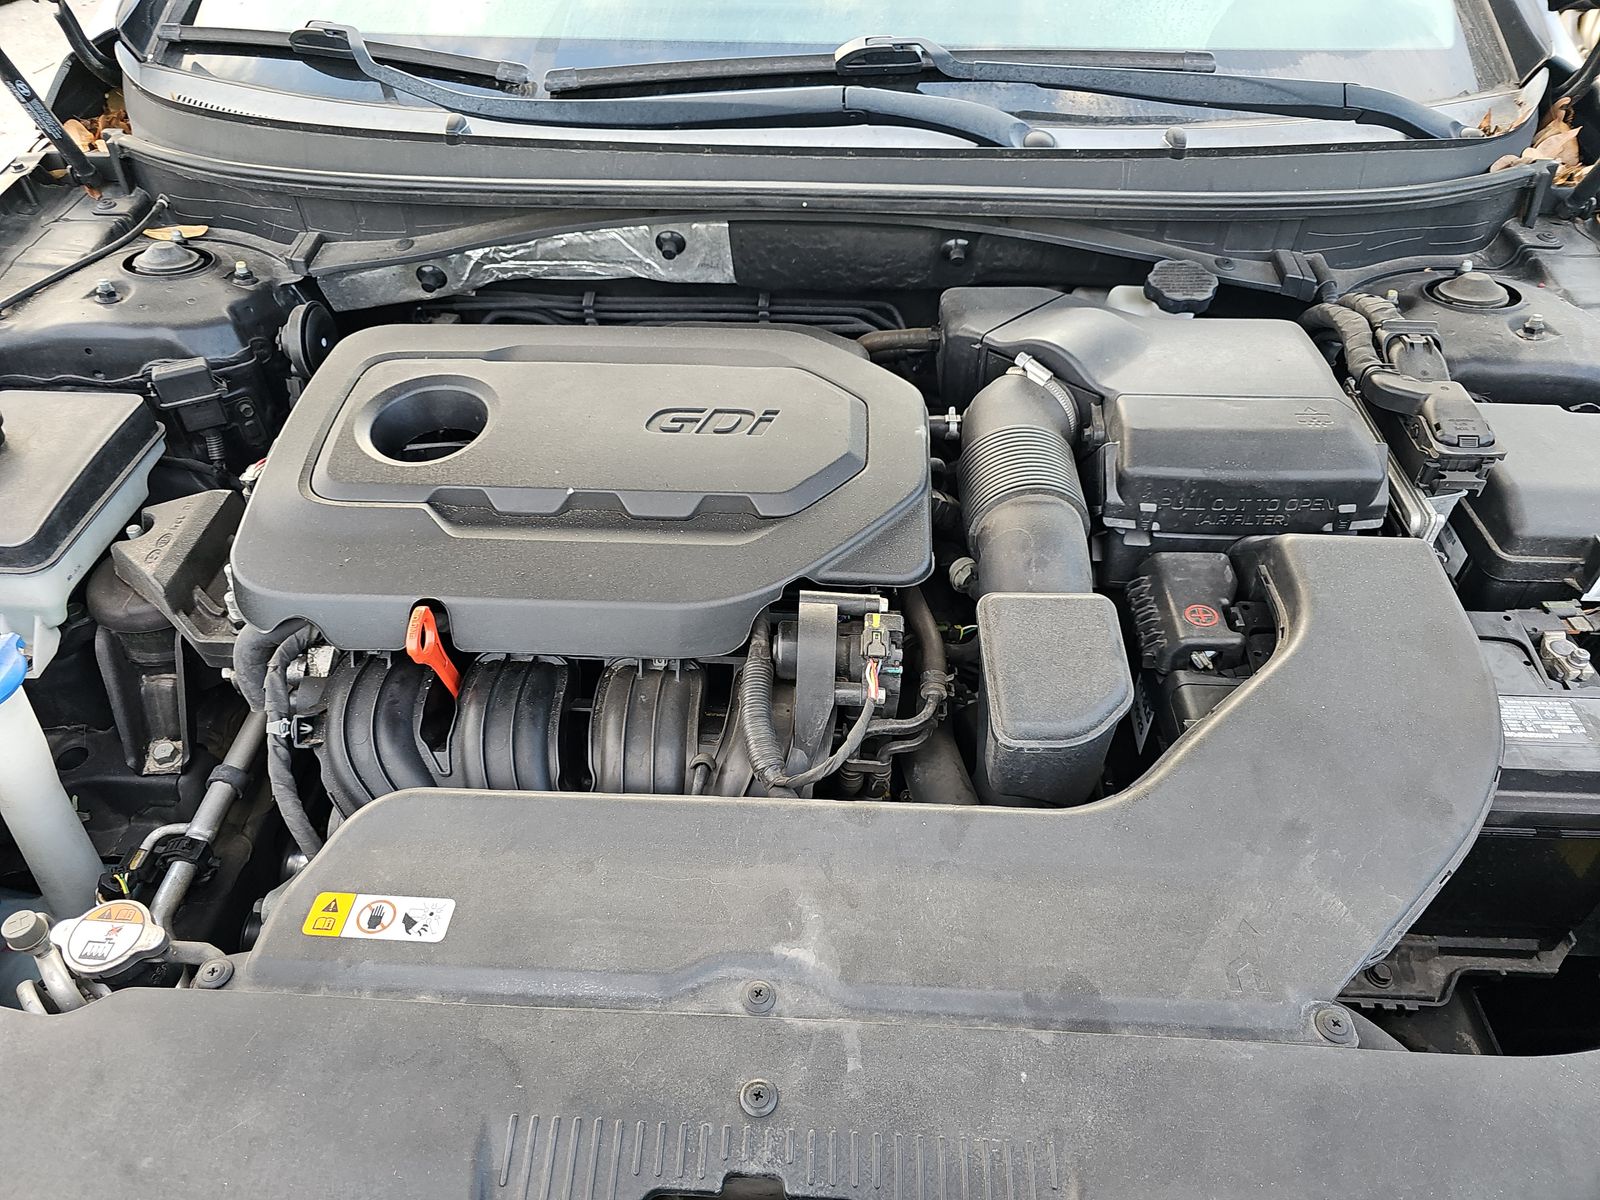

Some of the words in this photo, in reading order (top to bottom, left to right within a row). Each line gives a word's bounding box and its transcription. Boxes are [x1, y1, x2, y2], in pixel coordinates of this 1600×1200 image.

[645, 407, 781, 436] GDi
[1158, 497, 1206, 511] PULL
[1211, 498, 1253, 511] OUT
[1256, 498, 1281, 511] TO
[1284, 498, 1336, 511] OPEN
